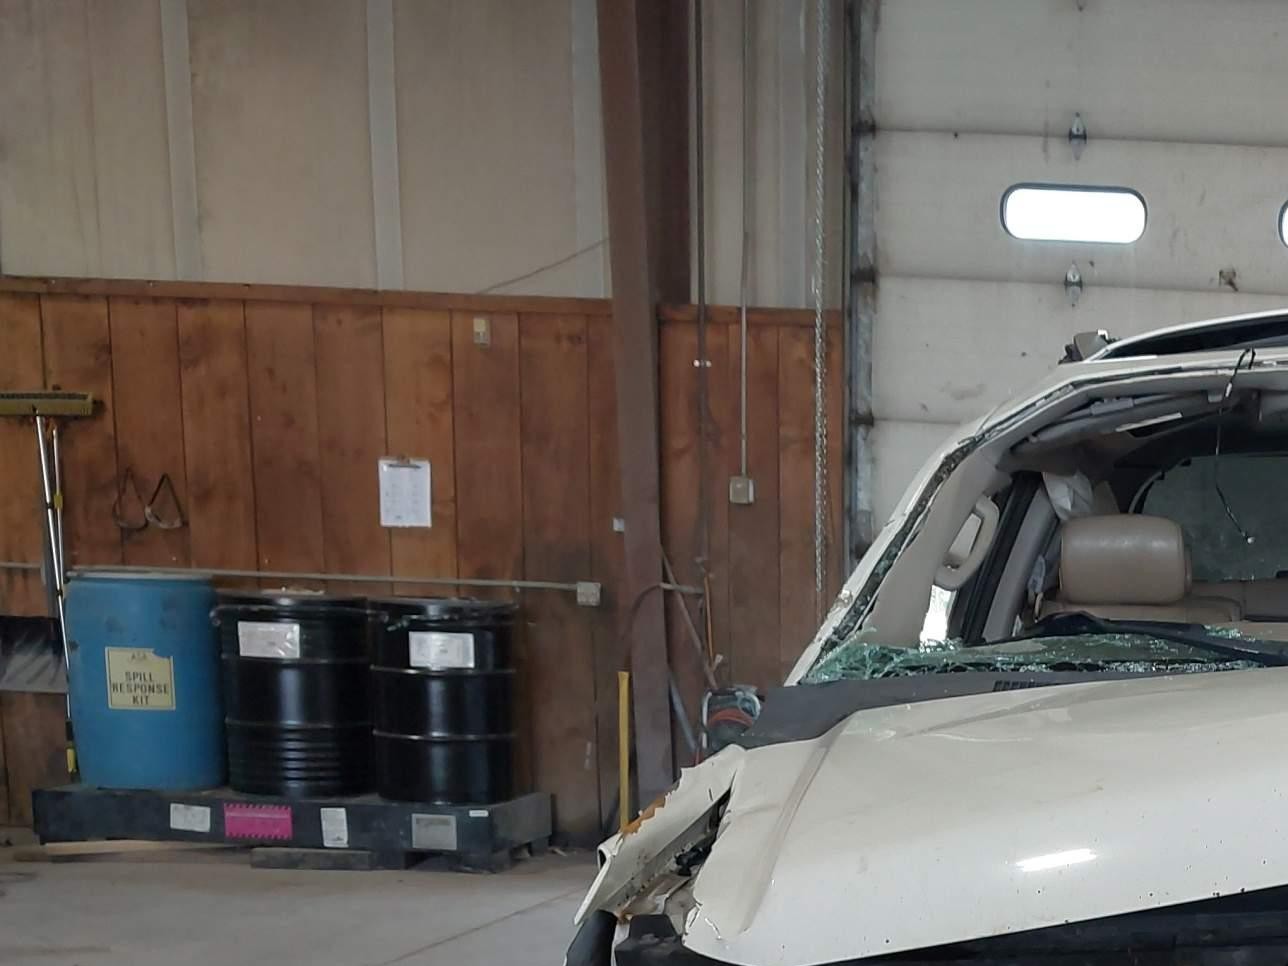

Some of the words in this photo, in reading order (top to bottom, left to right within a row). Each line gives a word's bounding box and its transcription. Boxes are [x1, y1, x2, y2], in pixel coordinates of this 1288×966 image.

[124, 671, 153, 682] SPILL
[112, 683, 167, 694] RESPONSE
[132, 695, 149, 705] KIT
